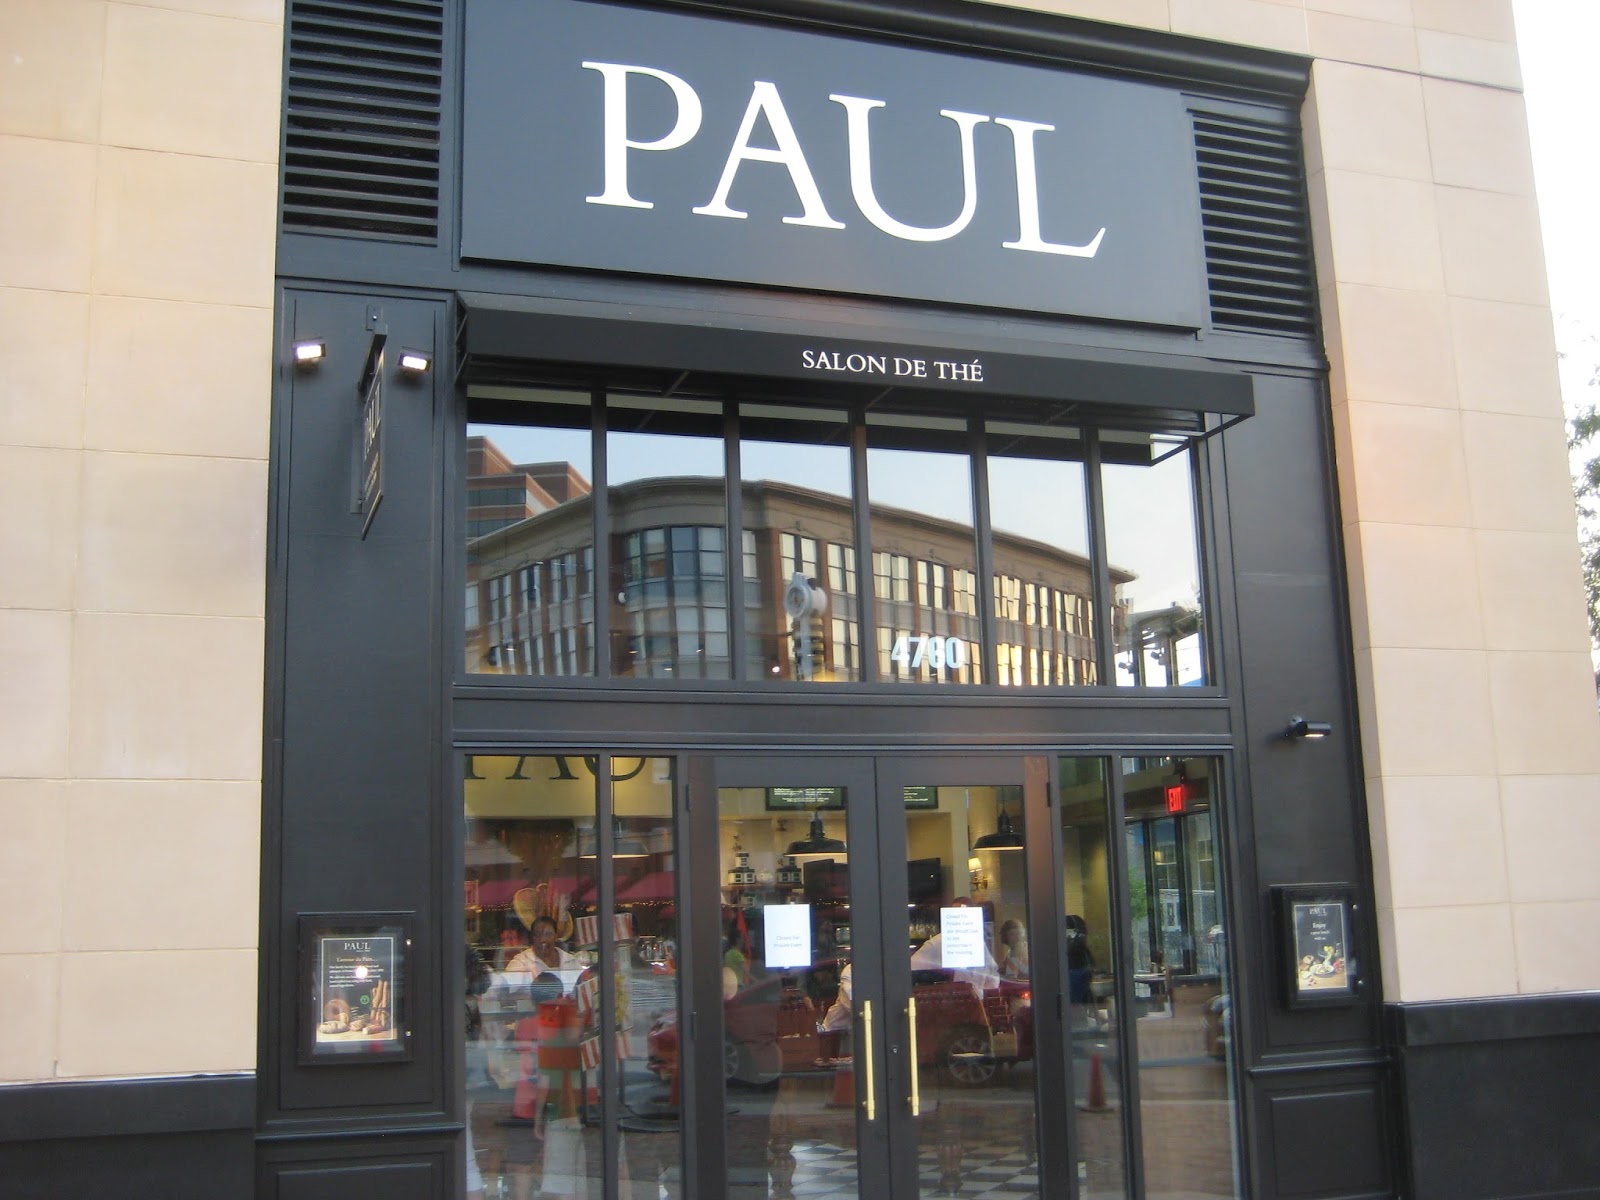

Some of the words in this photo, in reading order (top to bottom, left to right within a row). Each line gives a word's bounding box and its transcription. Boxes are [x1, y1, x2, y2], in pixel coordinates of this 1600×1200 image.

[582, 61, 1106, 258] PAUL
[801, 349, 887, 375] SALON
[893, 357, 928, 378] DE
[933, 358, 984, 382] THÉ
[891, 636, 966, 669] 4760
[344, 942, 371, 950] PAUL
